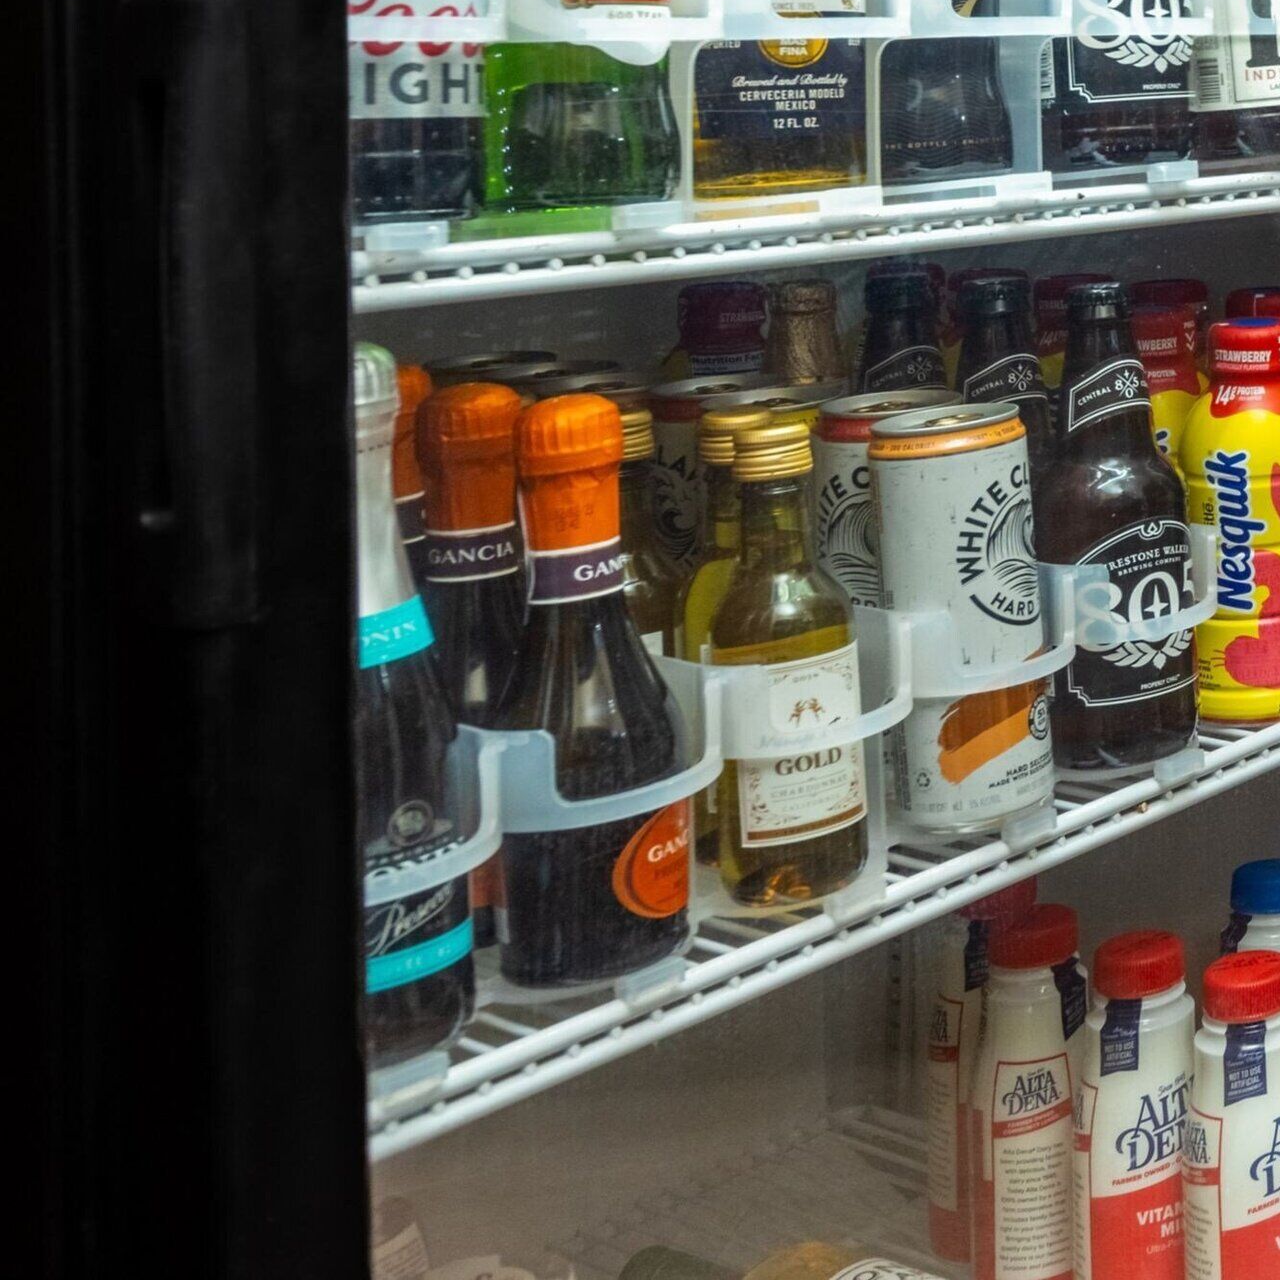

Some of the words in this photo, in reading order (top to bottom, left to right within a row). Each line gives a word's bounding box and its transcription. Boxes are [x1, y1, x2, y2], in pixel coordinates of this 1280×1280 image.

[780, 47, 807, 56] FINA
[777, 76, 797, 87] and
[800, 74, 836, 88] Bottled
[838, 75, 847, 88] by
[740, 89, 806, 101] CERVECERIA
[809, 88, 844, 98] MODELO
[775, 100, 815, 110] MEXICO
[773, 119, 784, 128] 12
[804, 117, 818, 127] OZ.
[1215, 350, 1271, 363] STRAWBERRY
[1078, 387, 1111, 407] CENTRAL
[956, 480, 1007, 583] WHITE
[1214, 450, 1266, 610] Nesquik
[429, 542, 513, 565] GANCIA
[991, 593, 1034, 616] HARD
[775, 748, 842, 776] GOLD
[1014, 1075, 1053, 1095] ALTA
[1002, 1089, 1059, 1116] DENA
